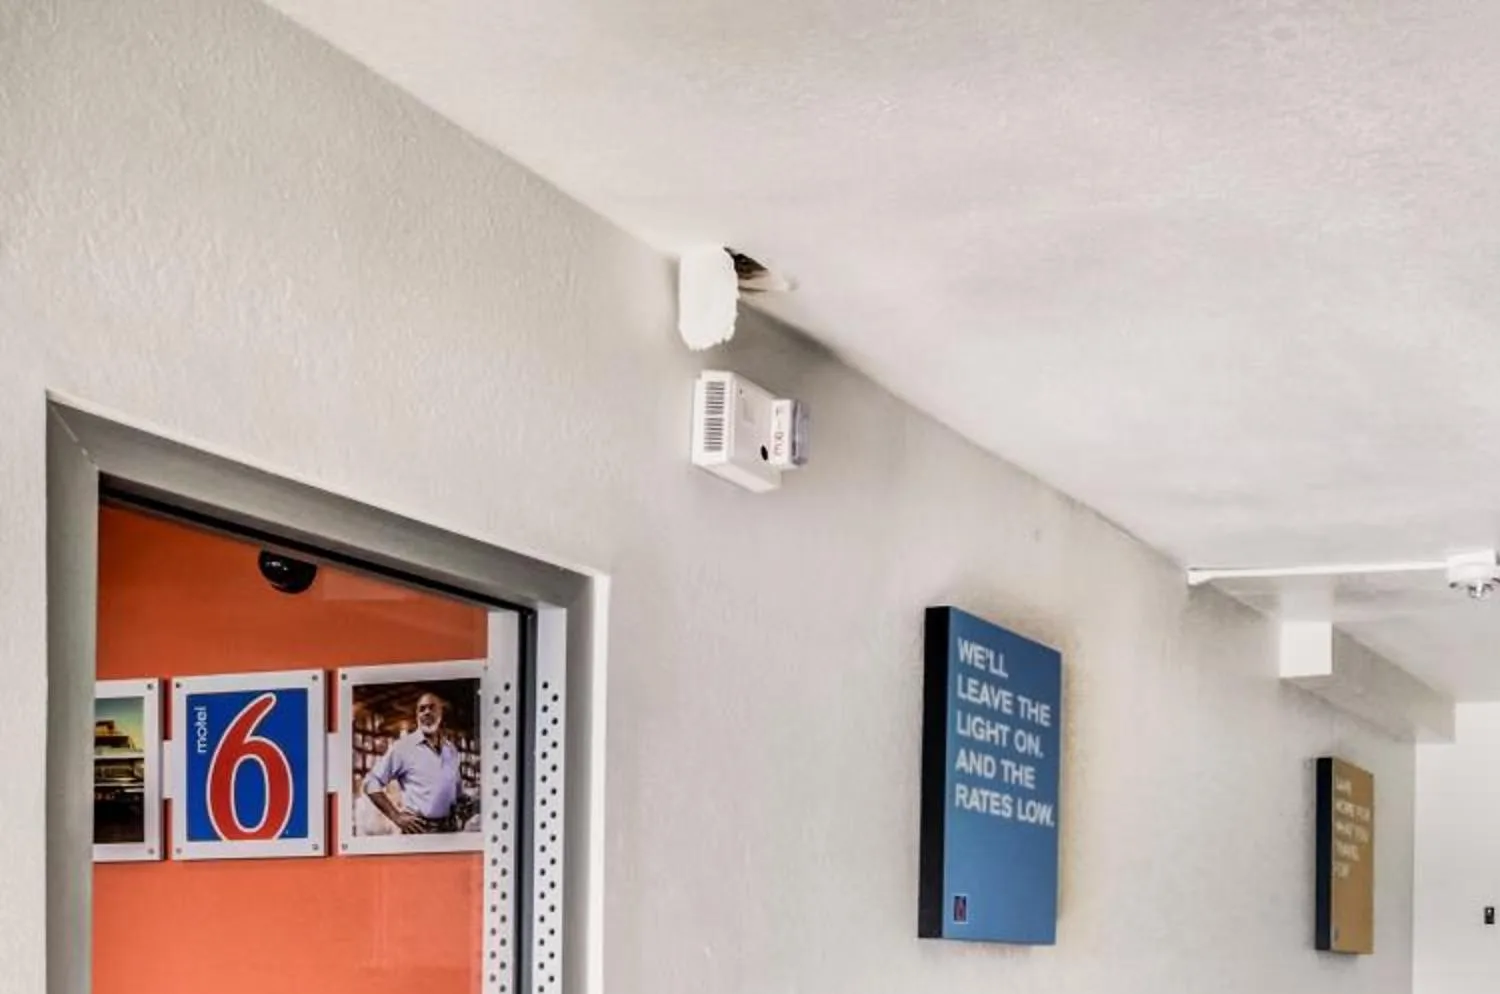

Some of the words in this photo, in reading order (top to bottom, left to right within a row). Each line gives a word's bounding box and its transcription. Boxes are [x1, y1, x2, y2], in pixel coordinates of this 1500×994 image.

[957, 637, 1008, 678] WE'LL
[957, 676, 1014, 715] LEAVE
[1018, 695, 1051, 727] THE
[194, 706, 207, 754] motel
[956, 711, 1010, 748] LIGHT
[206, 692, 294, 841] 6
[955, 749, 996, 779] AND
[1000, 760, 1036, 790] THE
[955, 784, 1013, 818] RATES
